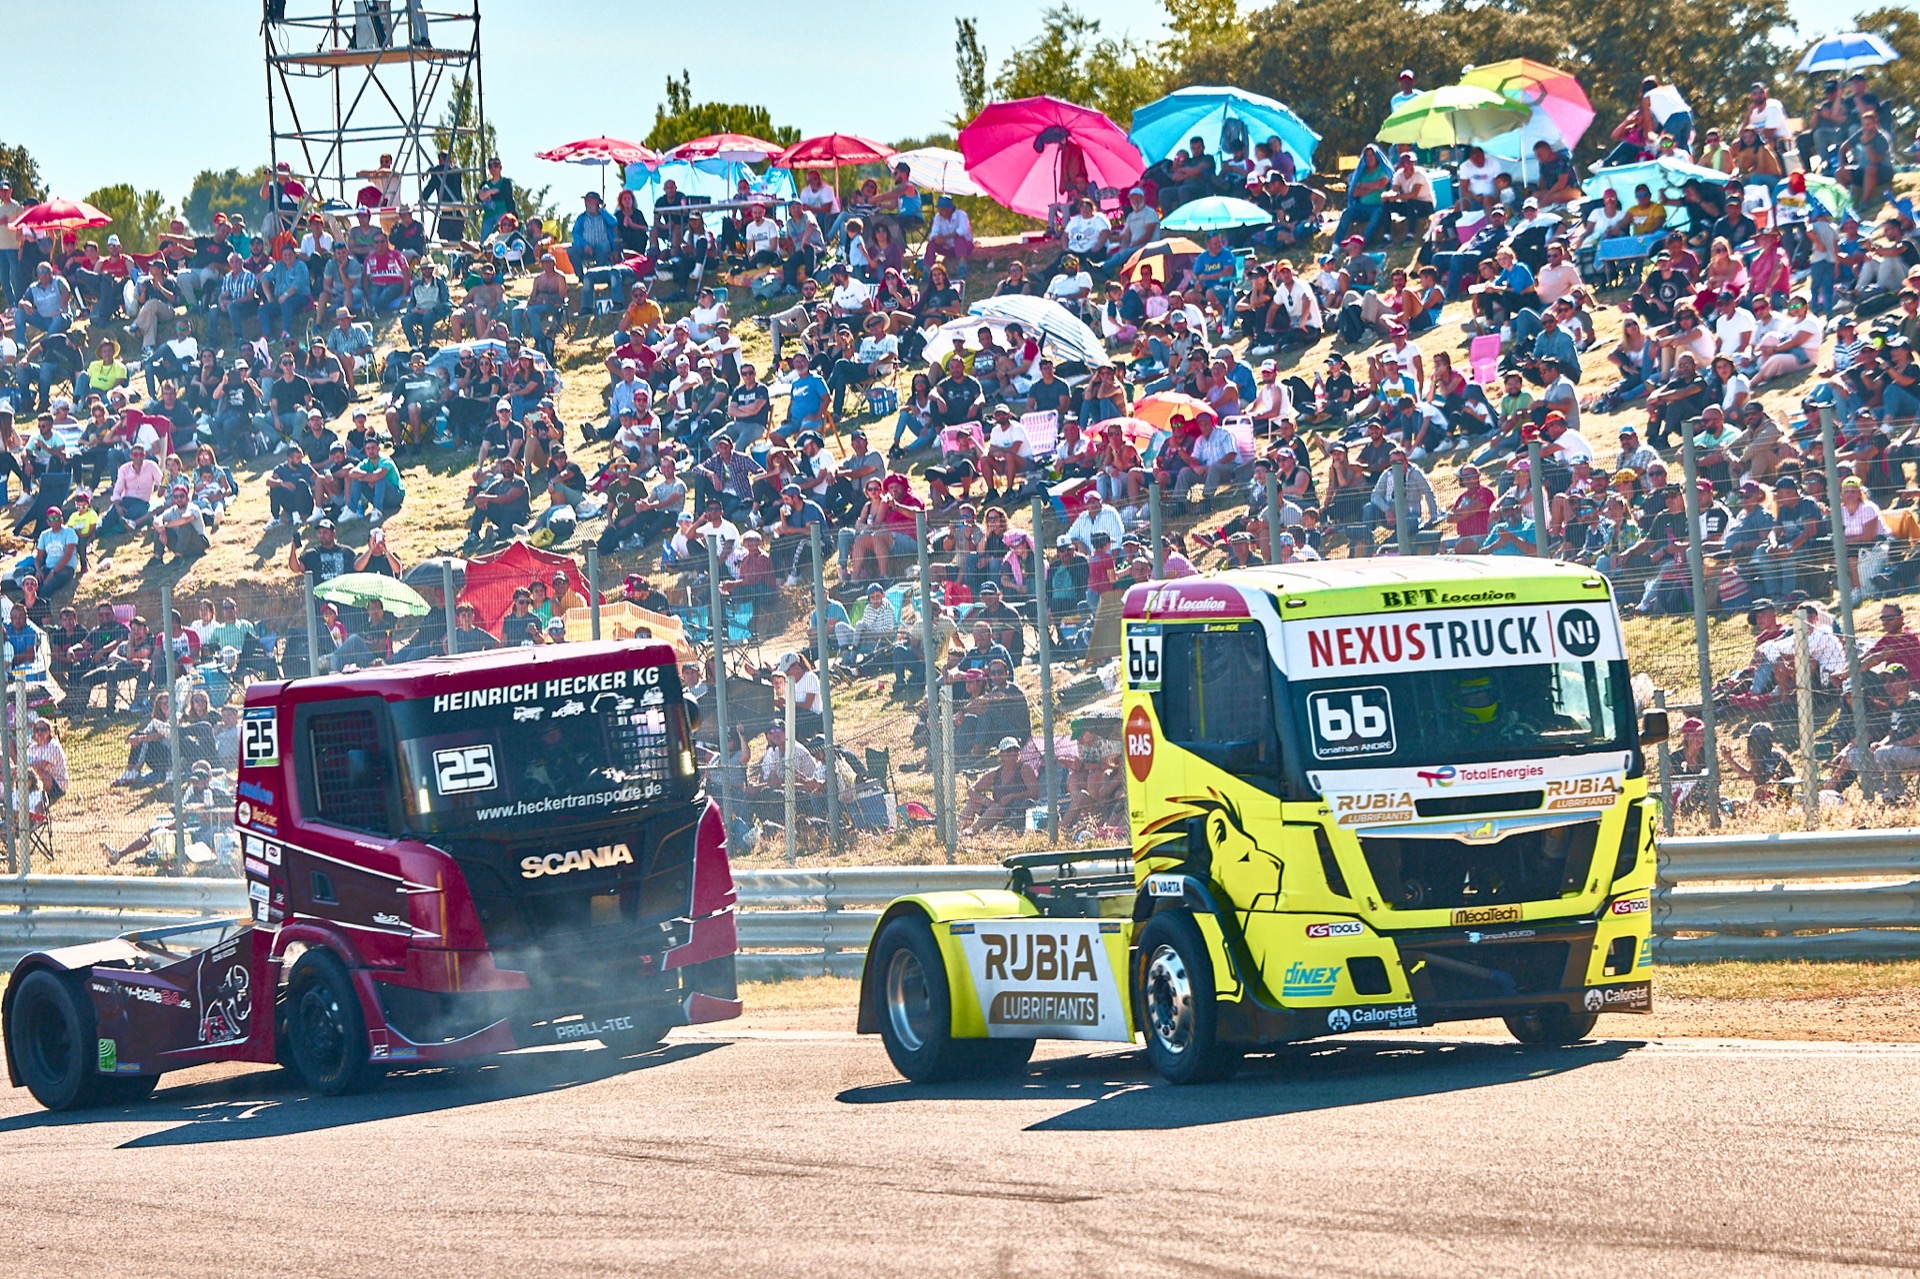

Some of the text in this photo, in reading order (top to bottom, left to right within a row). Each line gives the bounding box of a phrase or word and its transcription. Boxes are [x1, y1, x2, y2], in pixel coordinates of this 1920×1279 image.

[1142, 590, 1226, 612] BFT Location
[1381, 588, 1516, 608] BFT Location
[1307, 616, 1596, 668] NEXUSTRUCK N!
[433, 666, 660, 713] HEINRICH HECKER KG
[247, 720, 274, 758] 25
[1128, 733, 1152, 756] RAS
[1319, 744, 1359, 755] Jonathan
[437, 747, 494, 791] 25
[1460, 764, 1544, 781] TotalEnergies
[476, 781, 662, 821] www.heckertransporte.de
[1557, 795, 1614, 808] LUBRIFIANTS
[1348, 811, 1411, 823] LUBRIFIANTS
[520, 843, 634, 879] SCANIA
[1157, 881, 1180, 893] VARTA
[1614, 901, 1630, 913] KS
[1308, 923, 1361, 937] KS TOOLS
[1604, 986, 1648, 1002] Calorstat
[1003, 996, 1095, 1020] LUBRIFIANTS
[1352, 1004, 1417, 1021] Calorstat
[555, 1016, 634, 1039] PRALL-TEC
